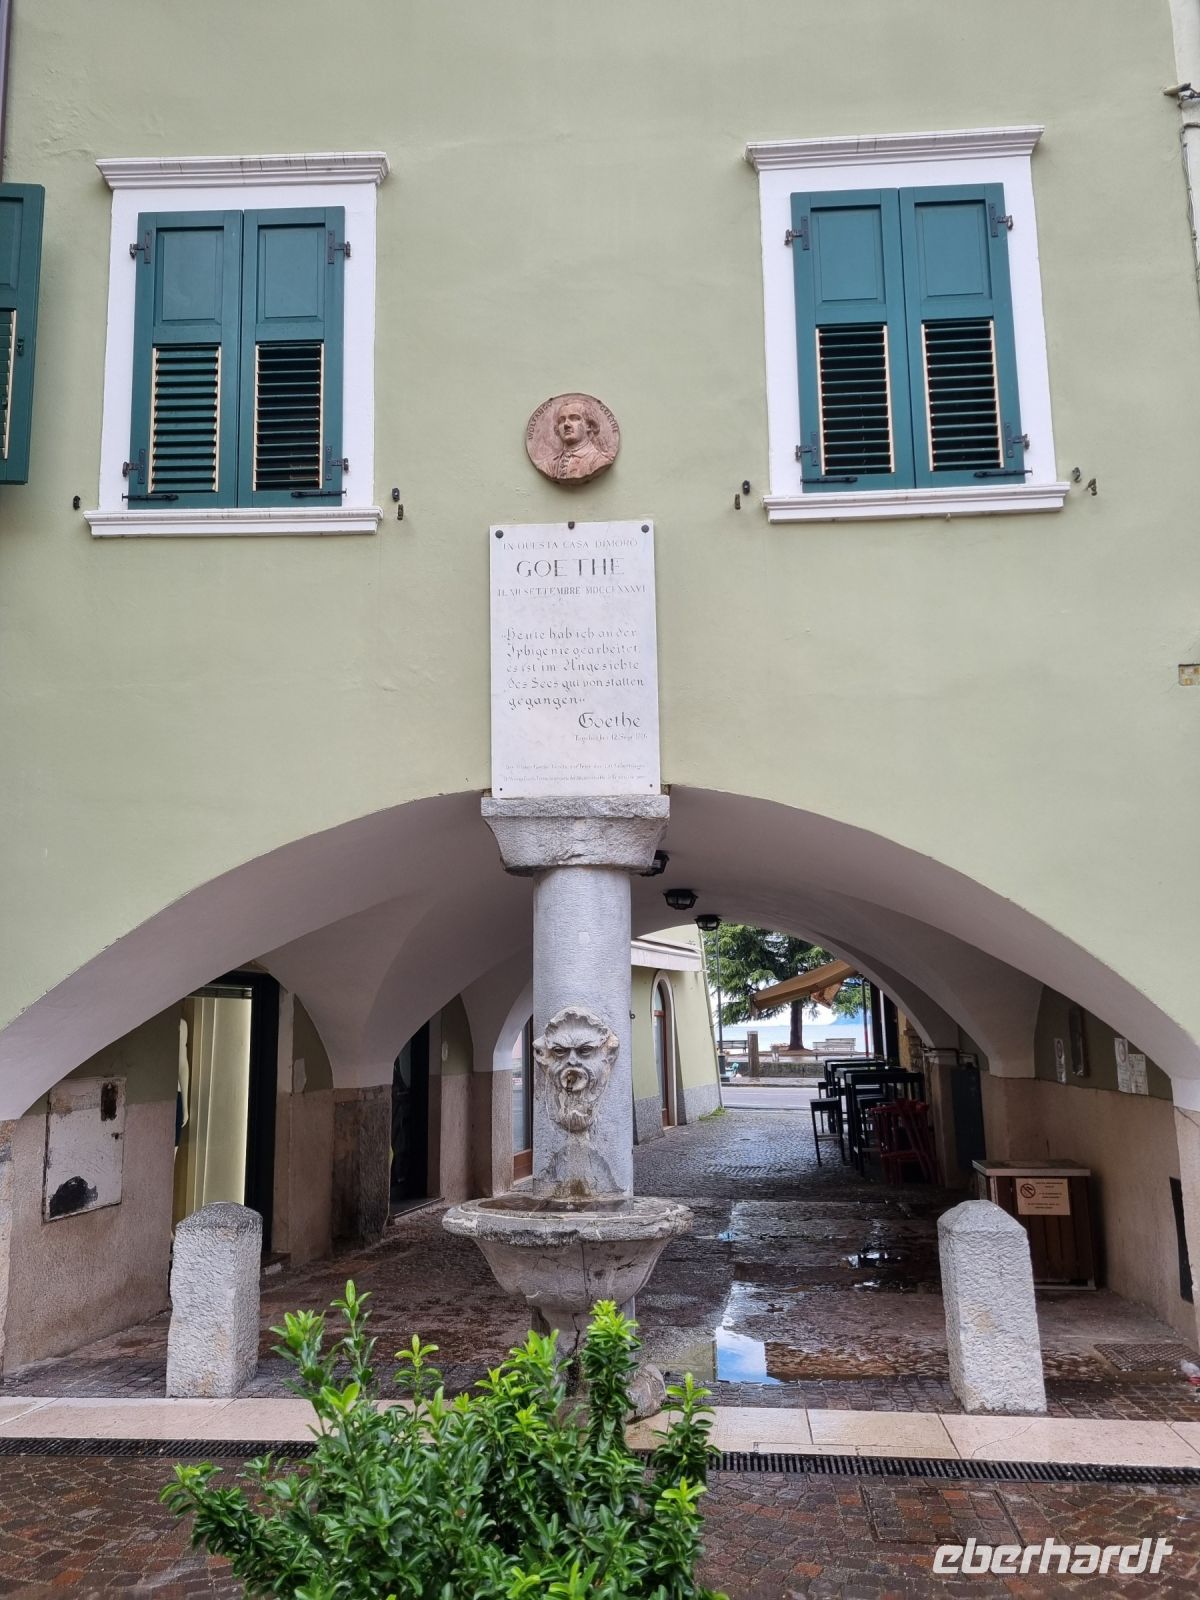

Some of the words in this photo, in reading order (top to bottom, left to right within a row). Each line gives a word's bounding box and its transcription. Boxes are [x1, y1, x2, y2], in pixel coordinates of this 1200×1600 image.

[599, 405, 620, 433] GOETHE
[563, 540, 589, 549] CASA
[516, 557, 625, 577] GOETHE
[524, 585, 580, 596] SETTEMBRE
[549, 626, 573, 639] hab
[598, 630, 613, 638] an
[541, 661, 557, 672] im
[578, 711, 641, 729] Goethe
